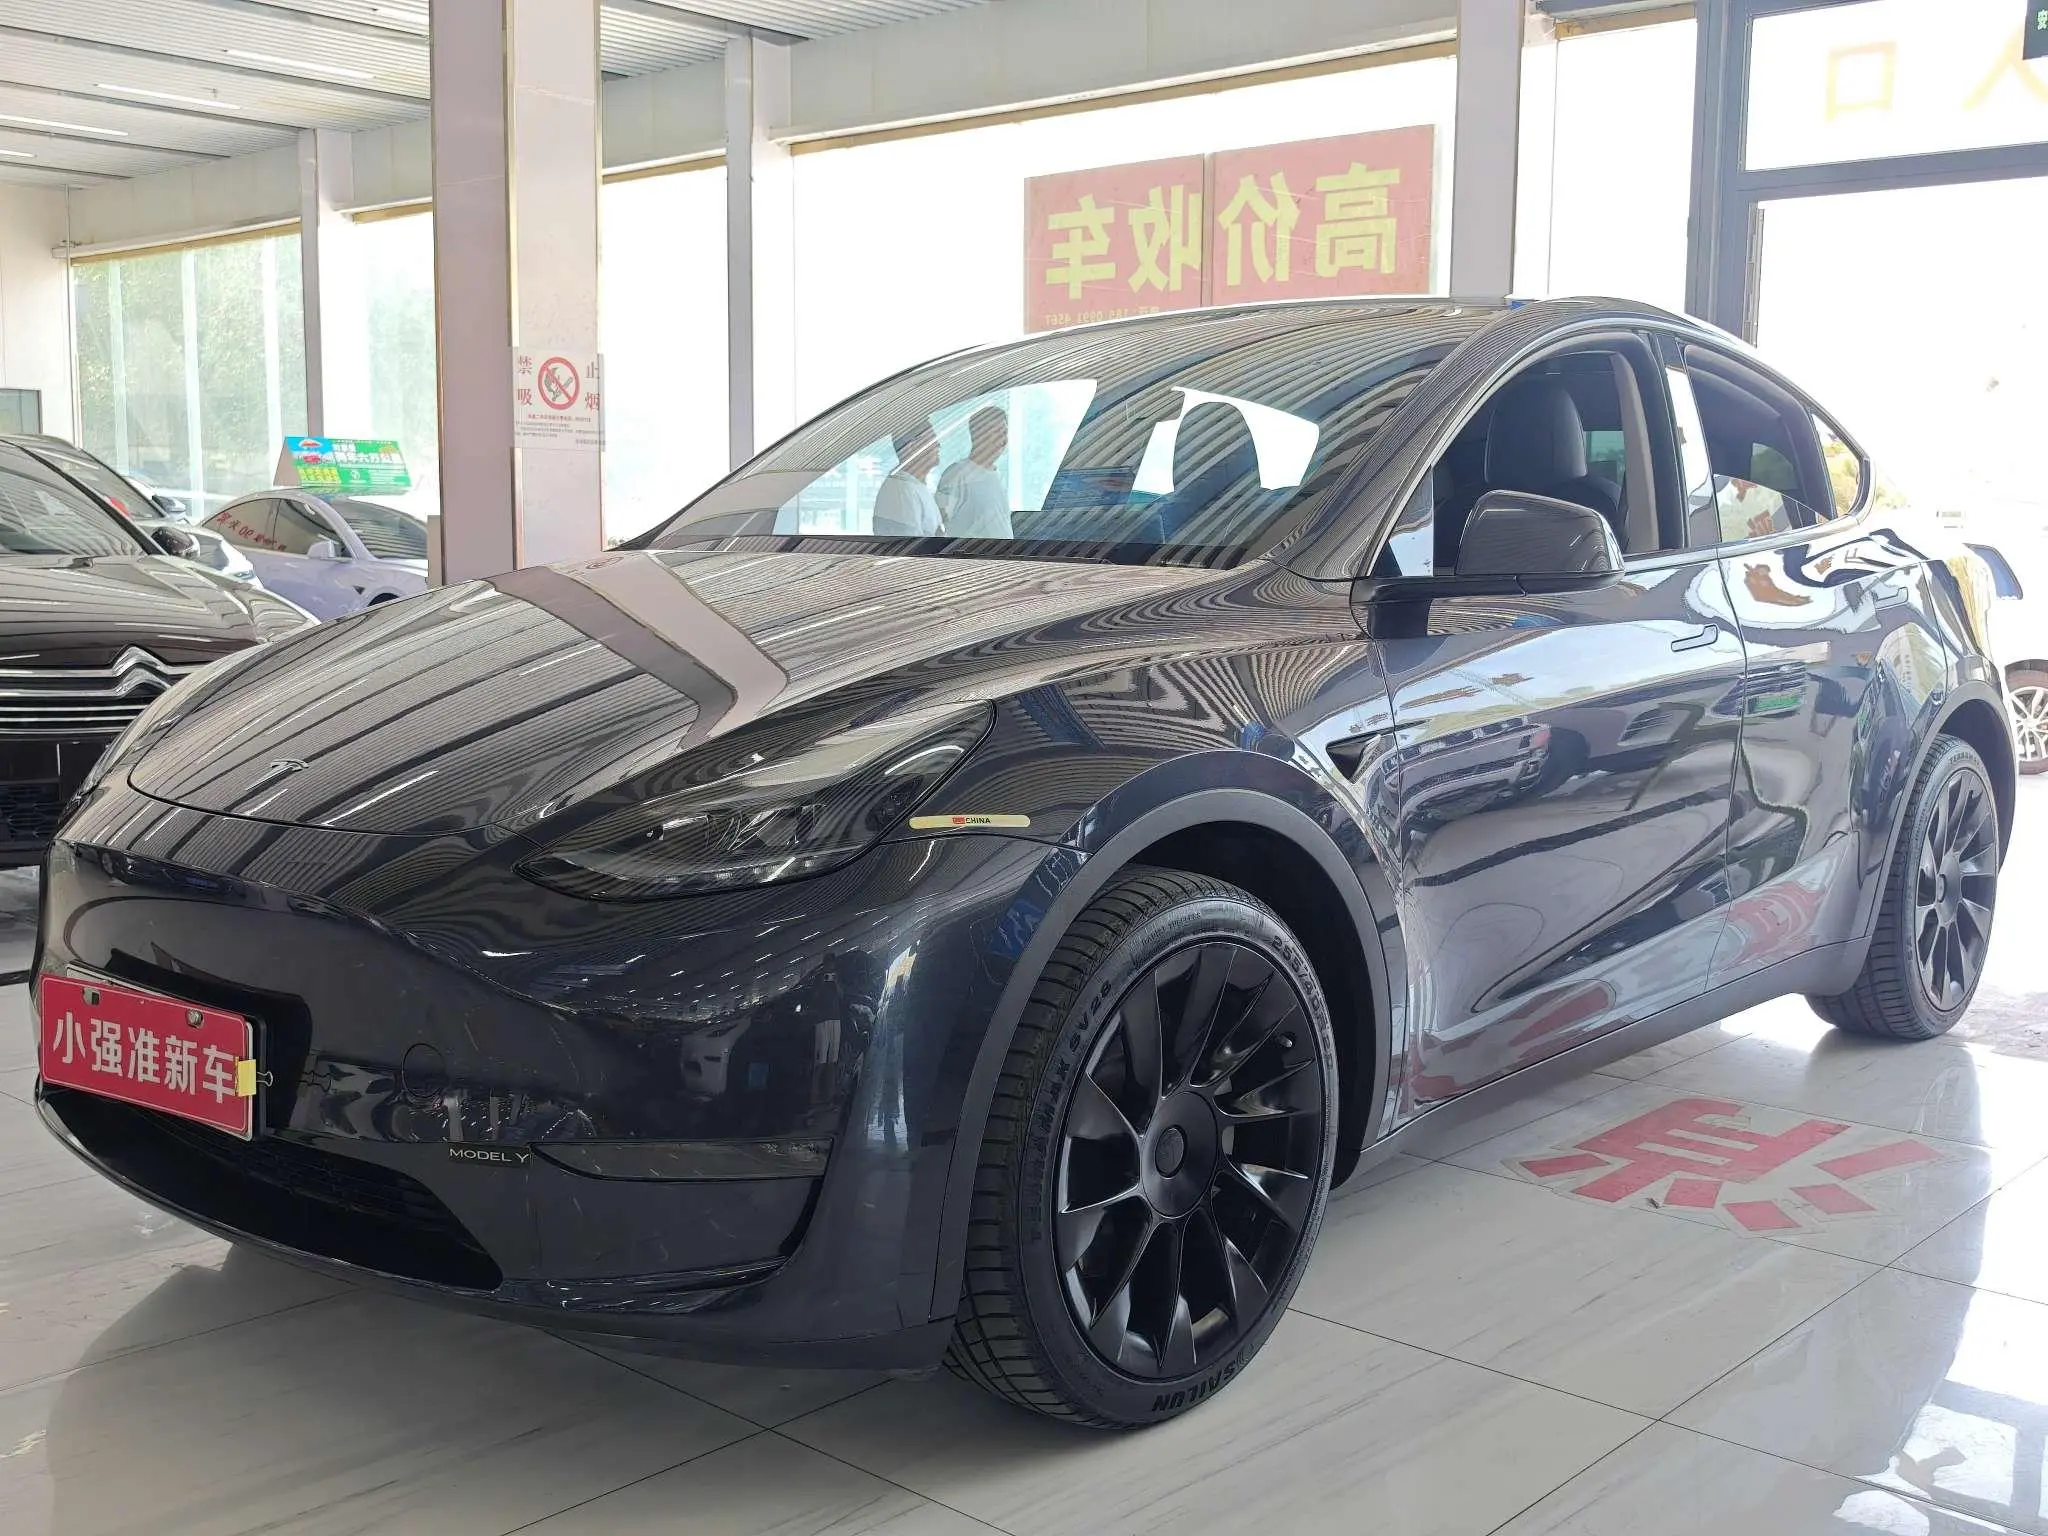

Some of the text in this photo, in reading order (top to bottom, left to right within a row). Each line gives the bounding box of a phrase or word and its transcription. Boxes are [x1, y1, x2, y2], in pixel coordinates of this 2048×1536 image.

[53, 1012, 236, 1103] 小强准新车
[449, 1148, 530, 1164] MODEL Y
[1151, 1359, 1237, 1412] SAILUN
